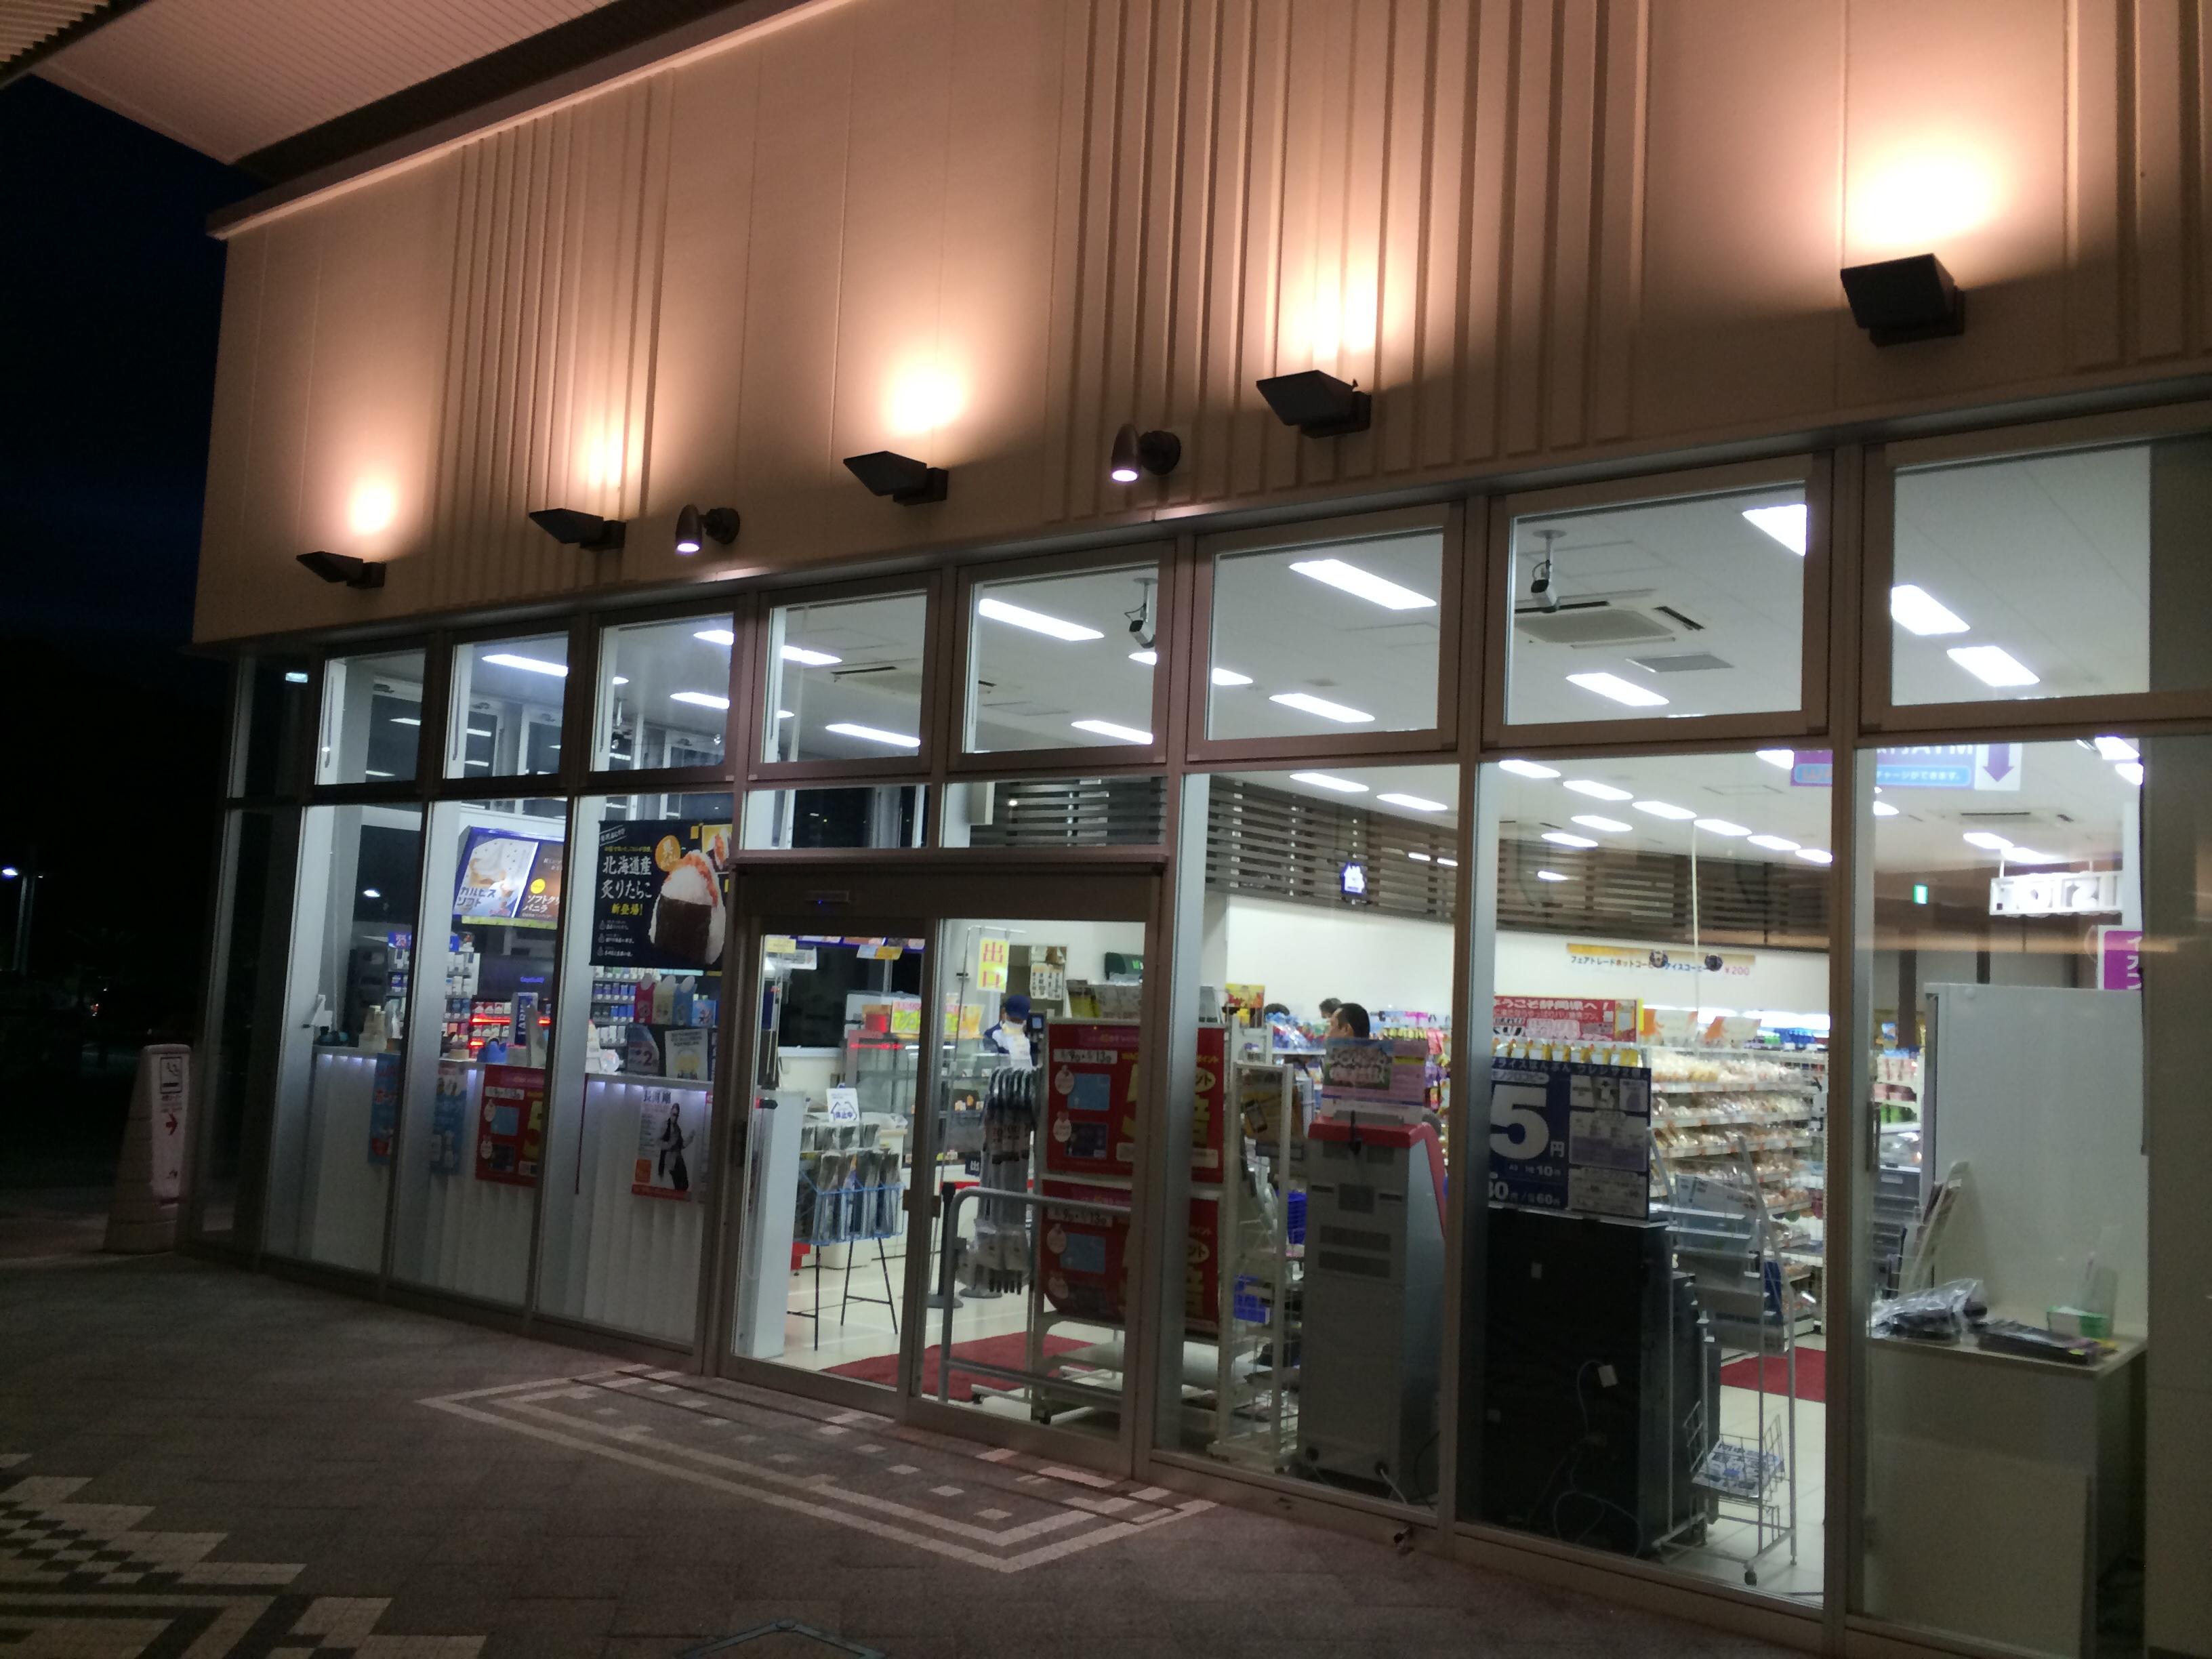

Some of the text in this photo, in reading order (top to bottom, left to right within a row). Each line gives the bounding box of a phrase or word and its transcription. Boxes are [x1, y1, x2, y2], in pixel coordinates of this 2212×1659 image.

[602, 855, 653, 875] 北海道産
[460, 886, 497, 898] カルピス
[600, 879, 653, 899] 炙りたらこ
[457, 897, 481, 907] ソフト
